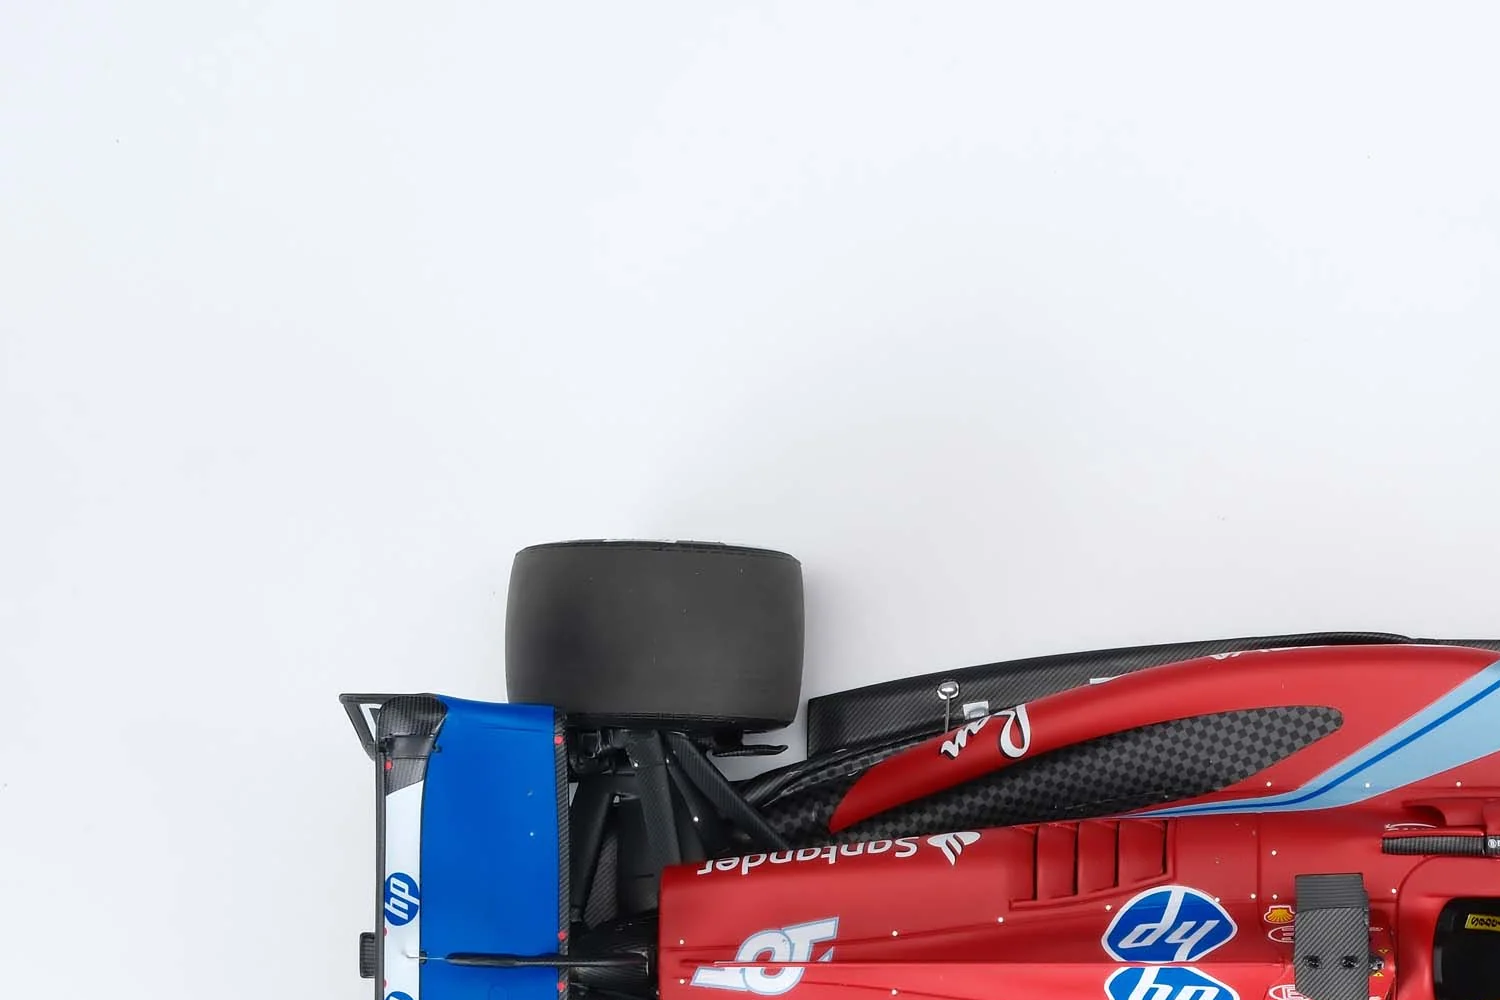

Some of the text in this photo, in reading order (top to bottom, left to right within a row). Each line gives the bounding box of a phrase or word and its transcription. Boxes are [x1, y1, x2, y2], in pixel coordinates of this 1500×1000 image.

[697, 836, 920, 875] Santander
[384, 876, 420, 922] hp
[1117, 890, 1222, 962] hp
